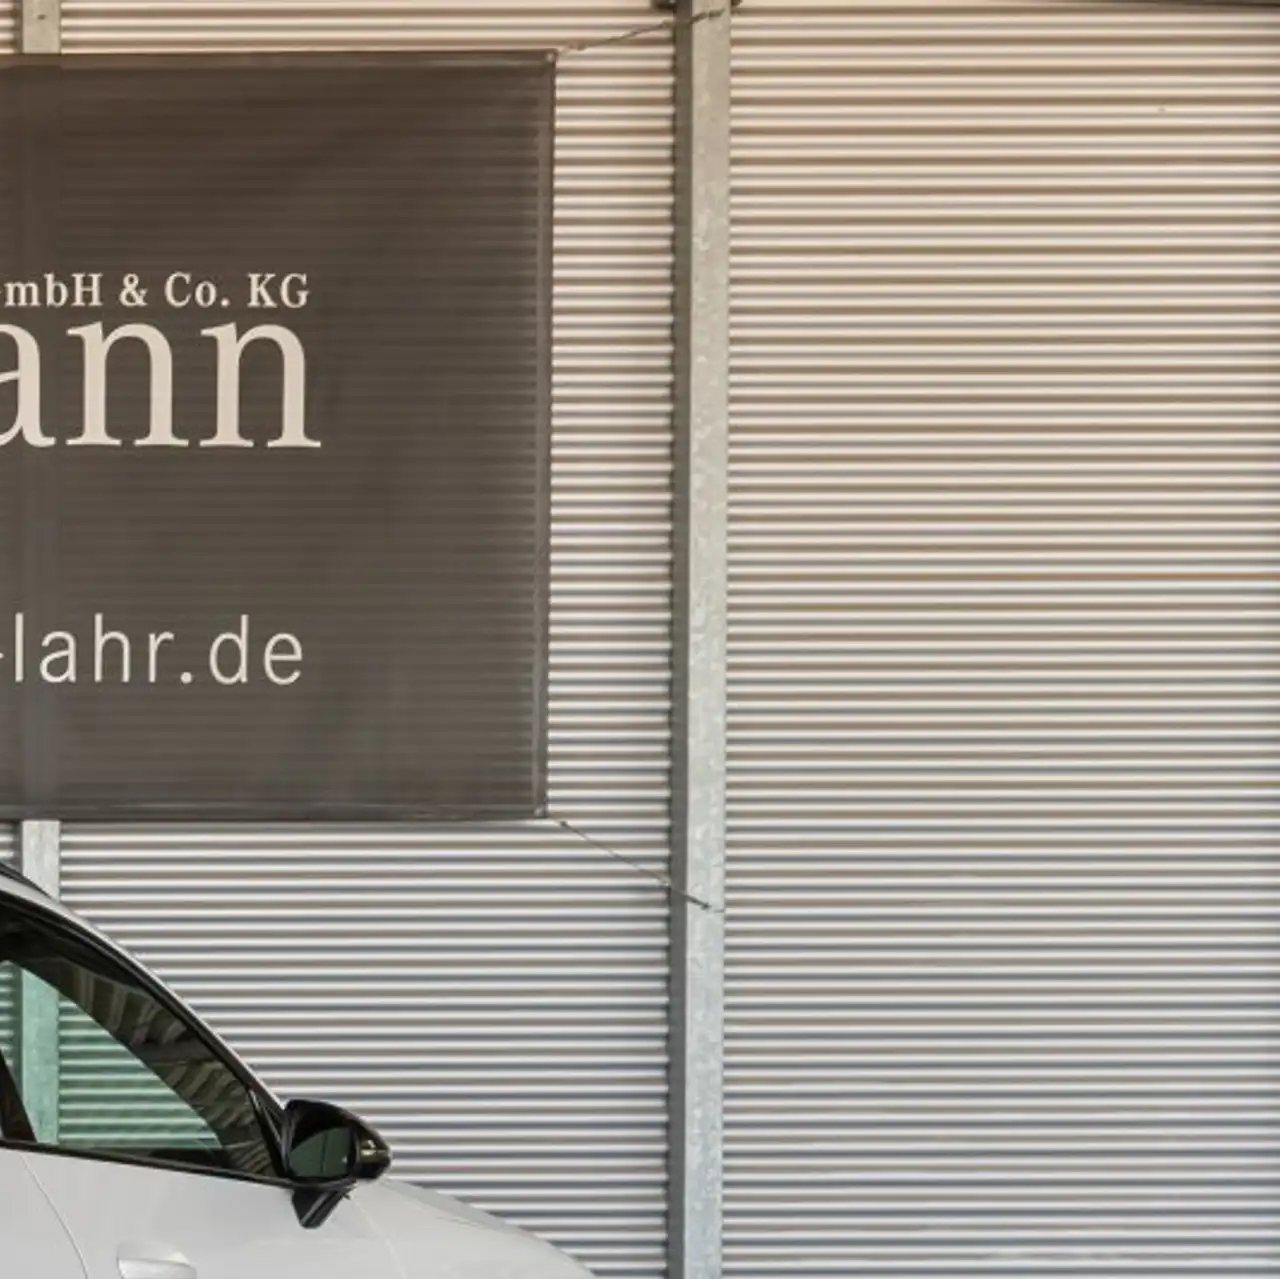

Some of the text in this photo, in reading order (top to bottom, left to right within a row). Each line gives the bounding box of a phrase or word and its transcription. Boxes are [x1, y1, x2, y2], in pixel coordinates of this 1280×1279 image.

[119, 273, 147, 307] &
[165, 272, 229, 308] Co.
[248, 273, 309, 308] KG
